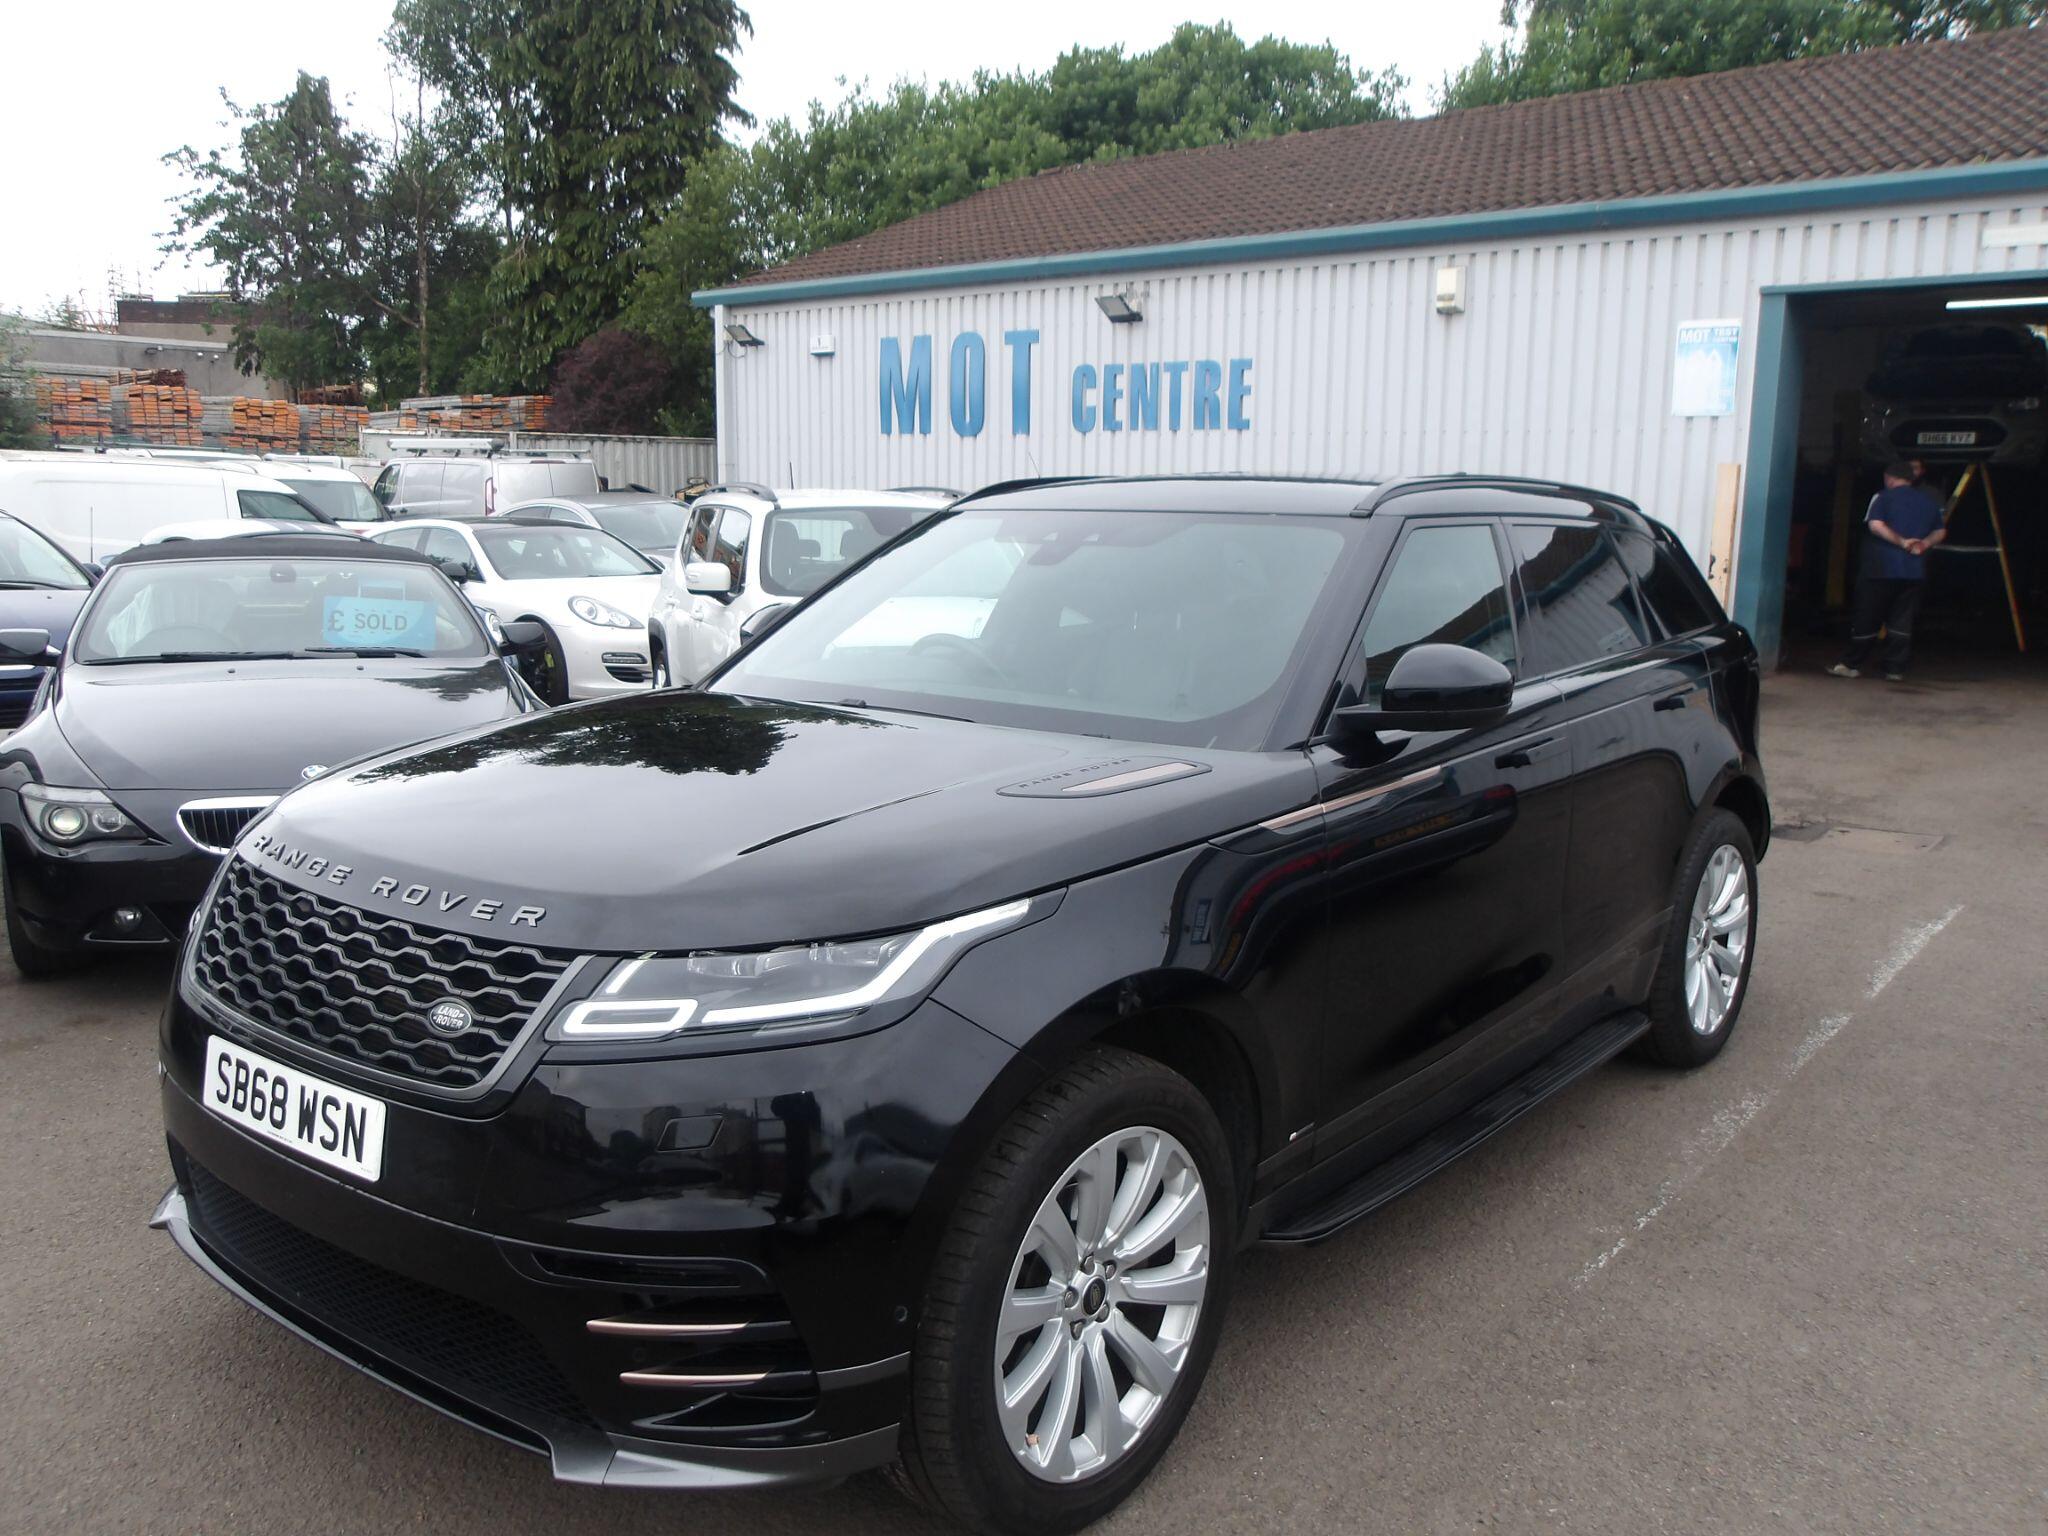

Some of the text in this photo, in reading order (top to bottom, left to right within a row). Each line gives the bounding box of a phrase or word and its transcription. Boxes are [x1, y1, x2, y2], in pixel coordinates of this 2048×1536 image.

[1680, 328, 1710, 344] MOT
[879, 329, 1253, 438] MOT CENTRE
[354, 613, 408, 631] SOLD
[253, 835, 547, 927] RANGE ROVER
[438, 1005, 461, 1018] LAND
[435, 1015, 464, 1029] ROVER
[216, 1051, 367, 1163] SB68 WSN
